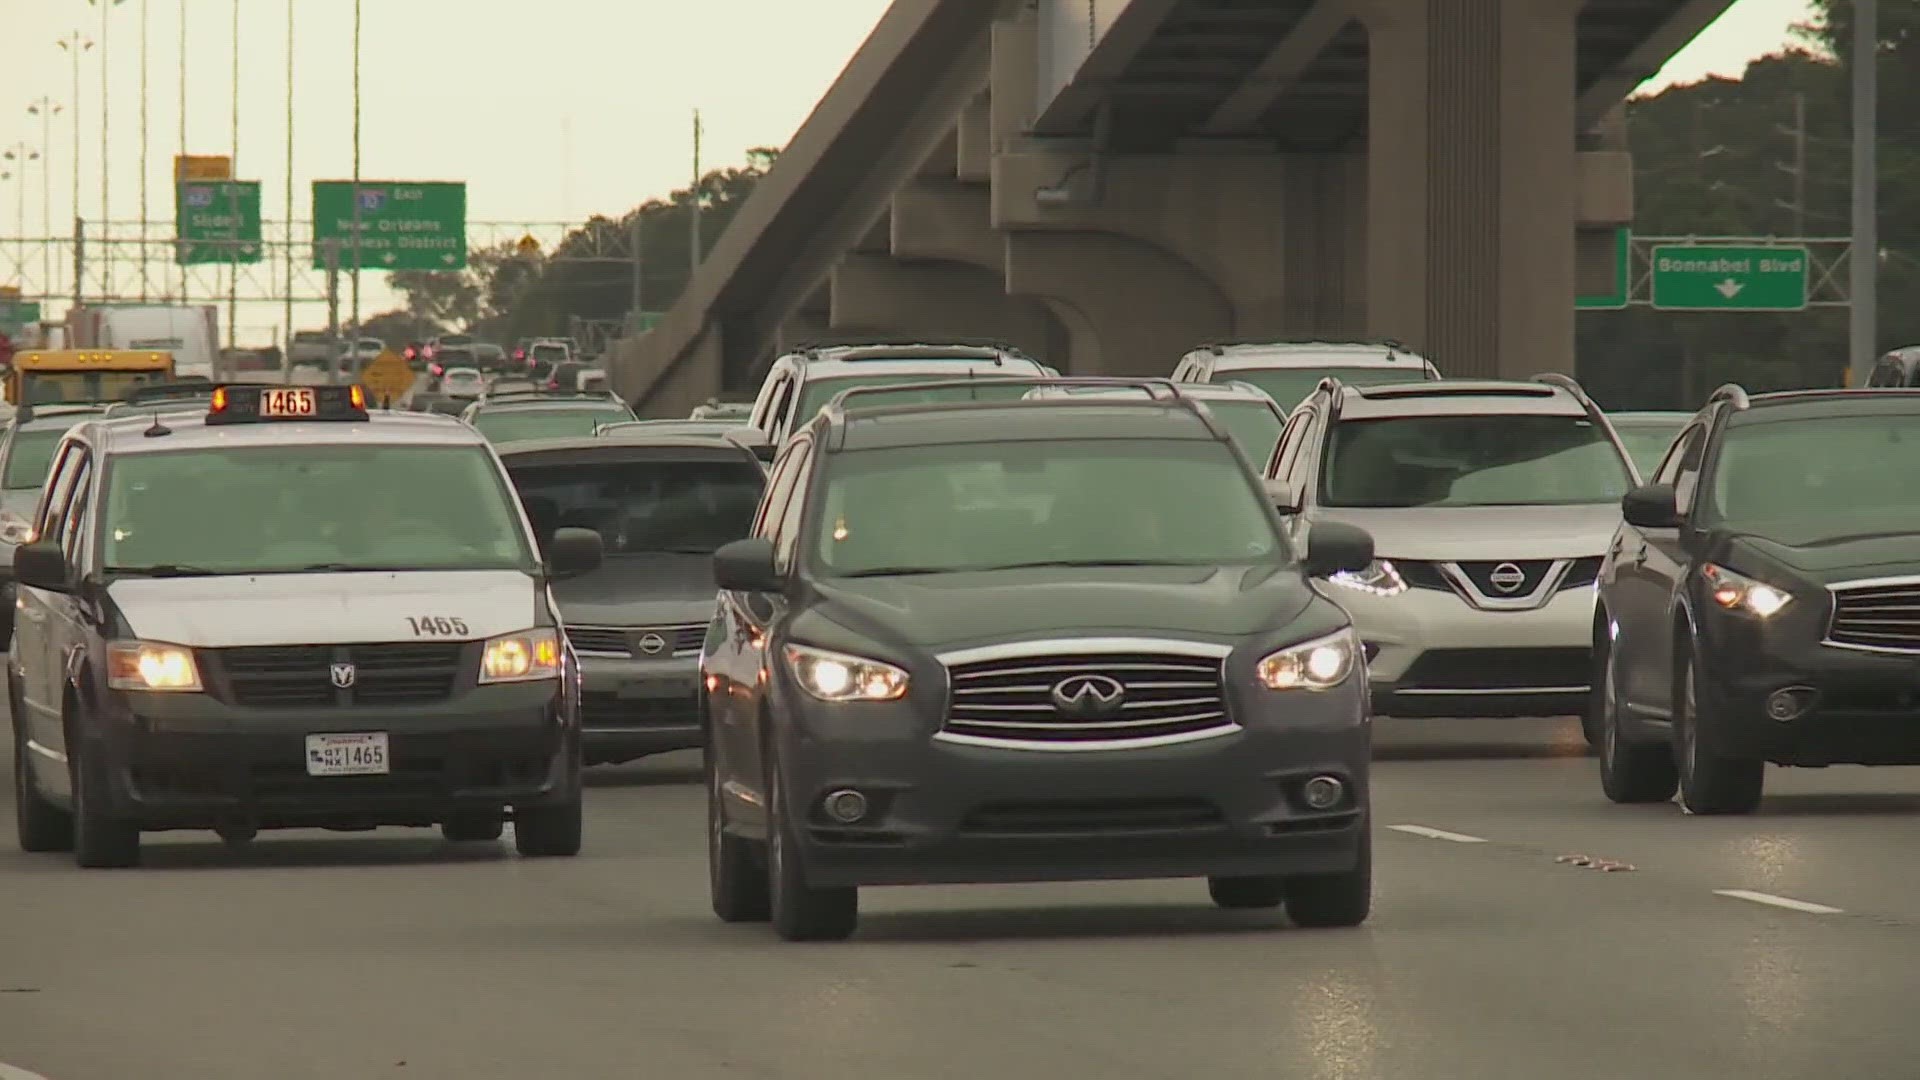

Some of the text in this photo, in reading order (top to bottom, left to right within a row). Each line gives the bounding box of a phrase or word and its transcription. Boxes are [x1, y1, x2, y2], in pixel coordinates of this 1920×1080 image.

[378, 218, 441, 231] Orleans
[398, 235, 457, 249] District
[1659, 257, 1801, 272] Bonnabel Blvd
[262, 391, 311, 414] 1465
[404, 616, 469, 636] 1465
[345, 745, 383, 766] 1465
